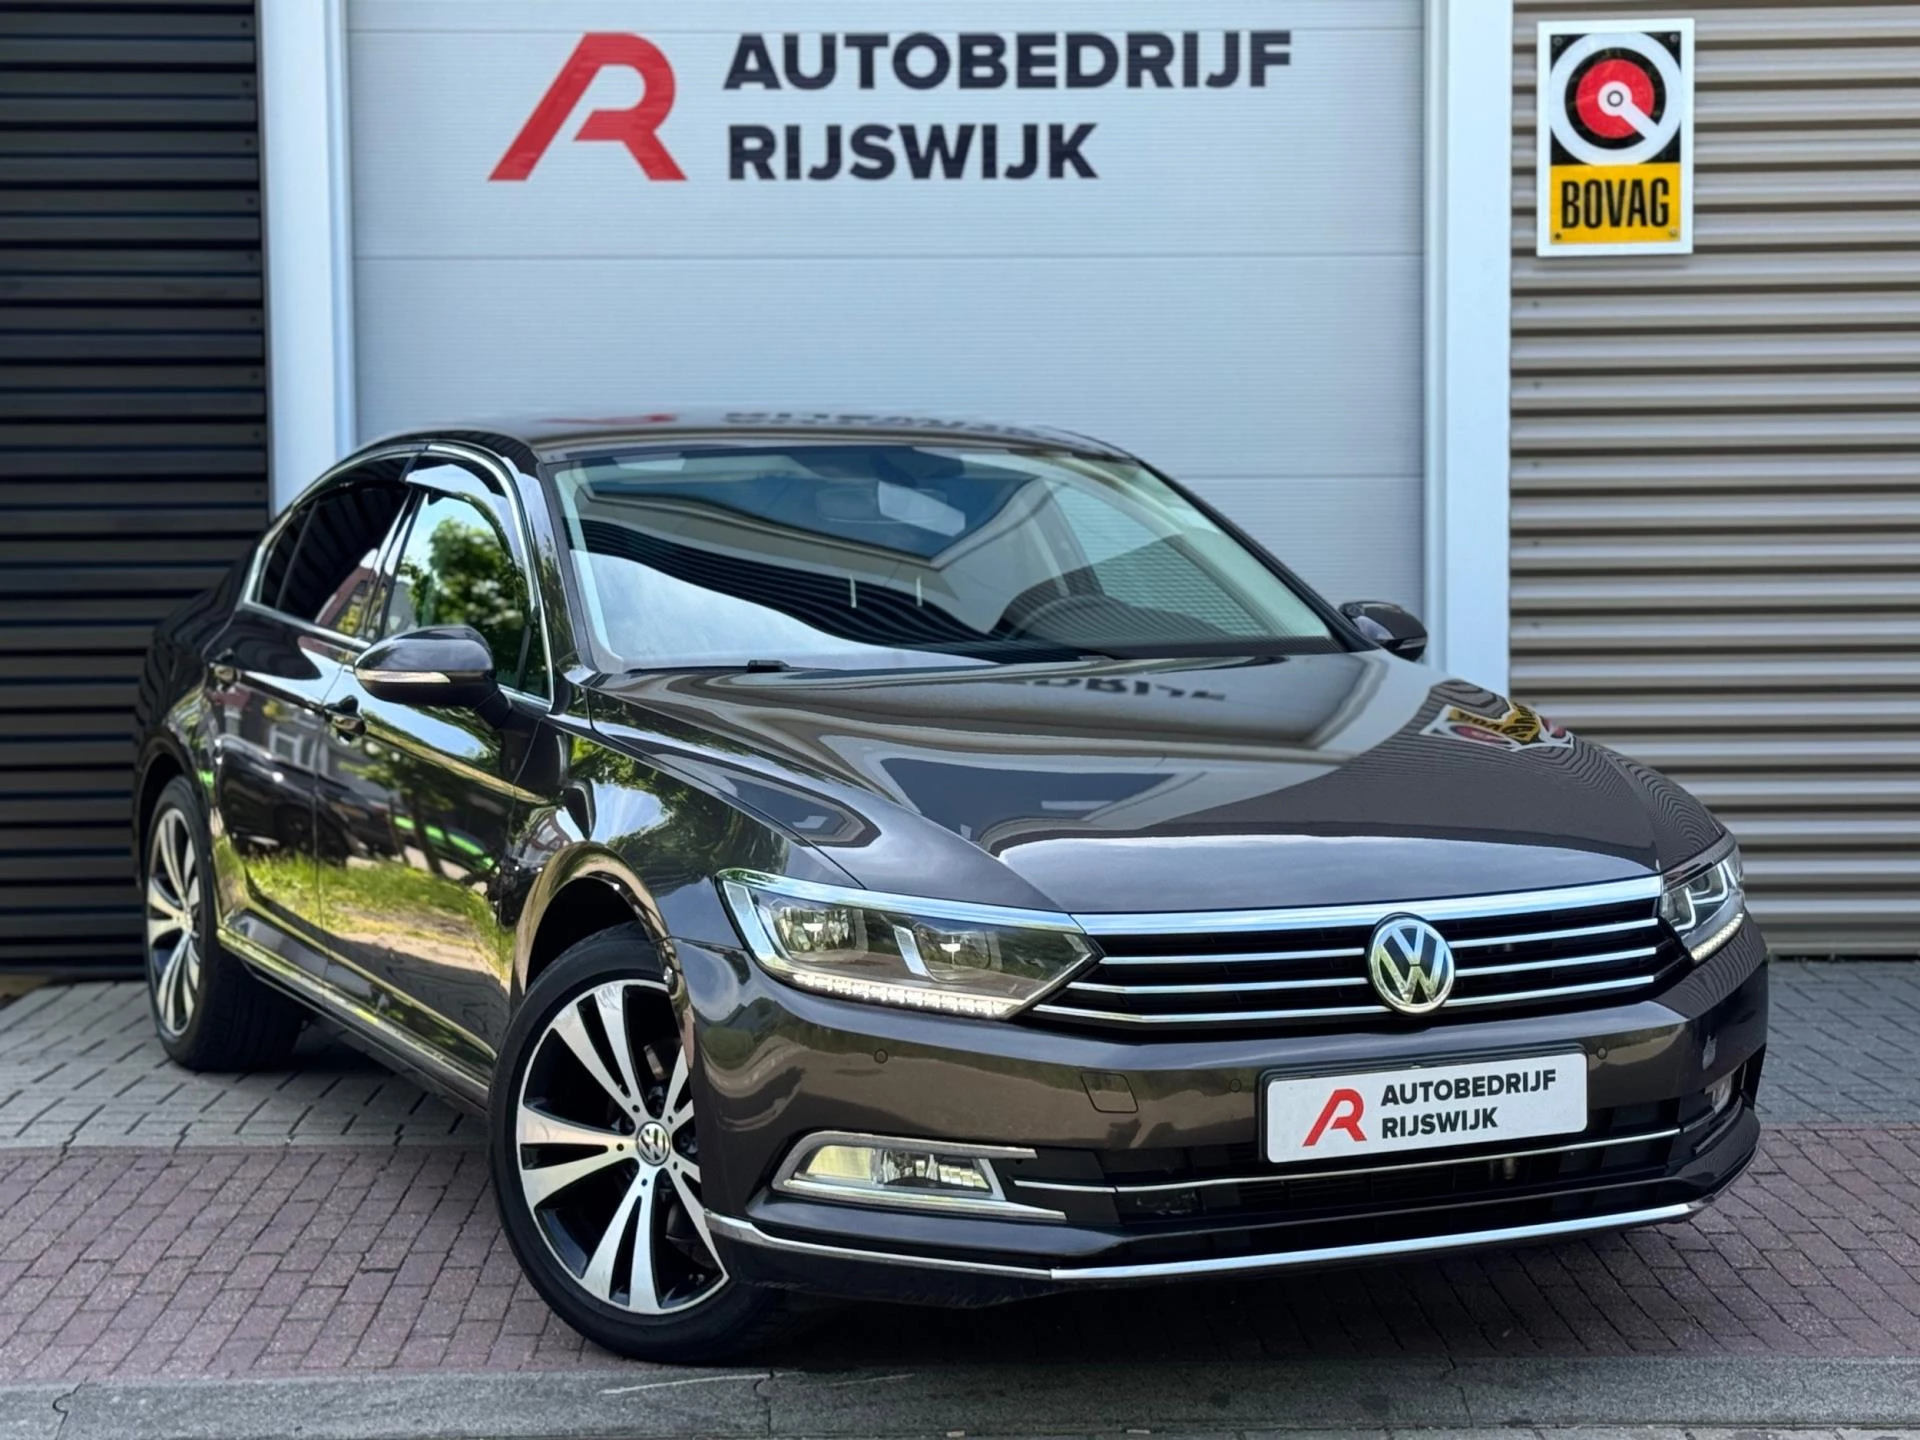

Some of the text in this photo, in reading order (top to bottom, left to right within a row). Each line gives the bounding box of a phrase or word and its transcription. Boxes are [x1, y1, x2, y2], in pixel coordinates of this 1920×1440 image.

[723, 29, 1293, 91] AUTOBEDRIJF
[728, 123, 1099, 181] RIJSWIJK
[1561, 177, 1670, 229] BOVAG
[1380, 1068, 1557, 1107] AUTOBEDRIJF
[1381, 1106, 1499, 1140] RIJSWIJK
